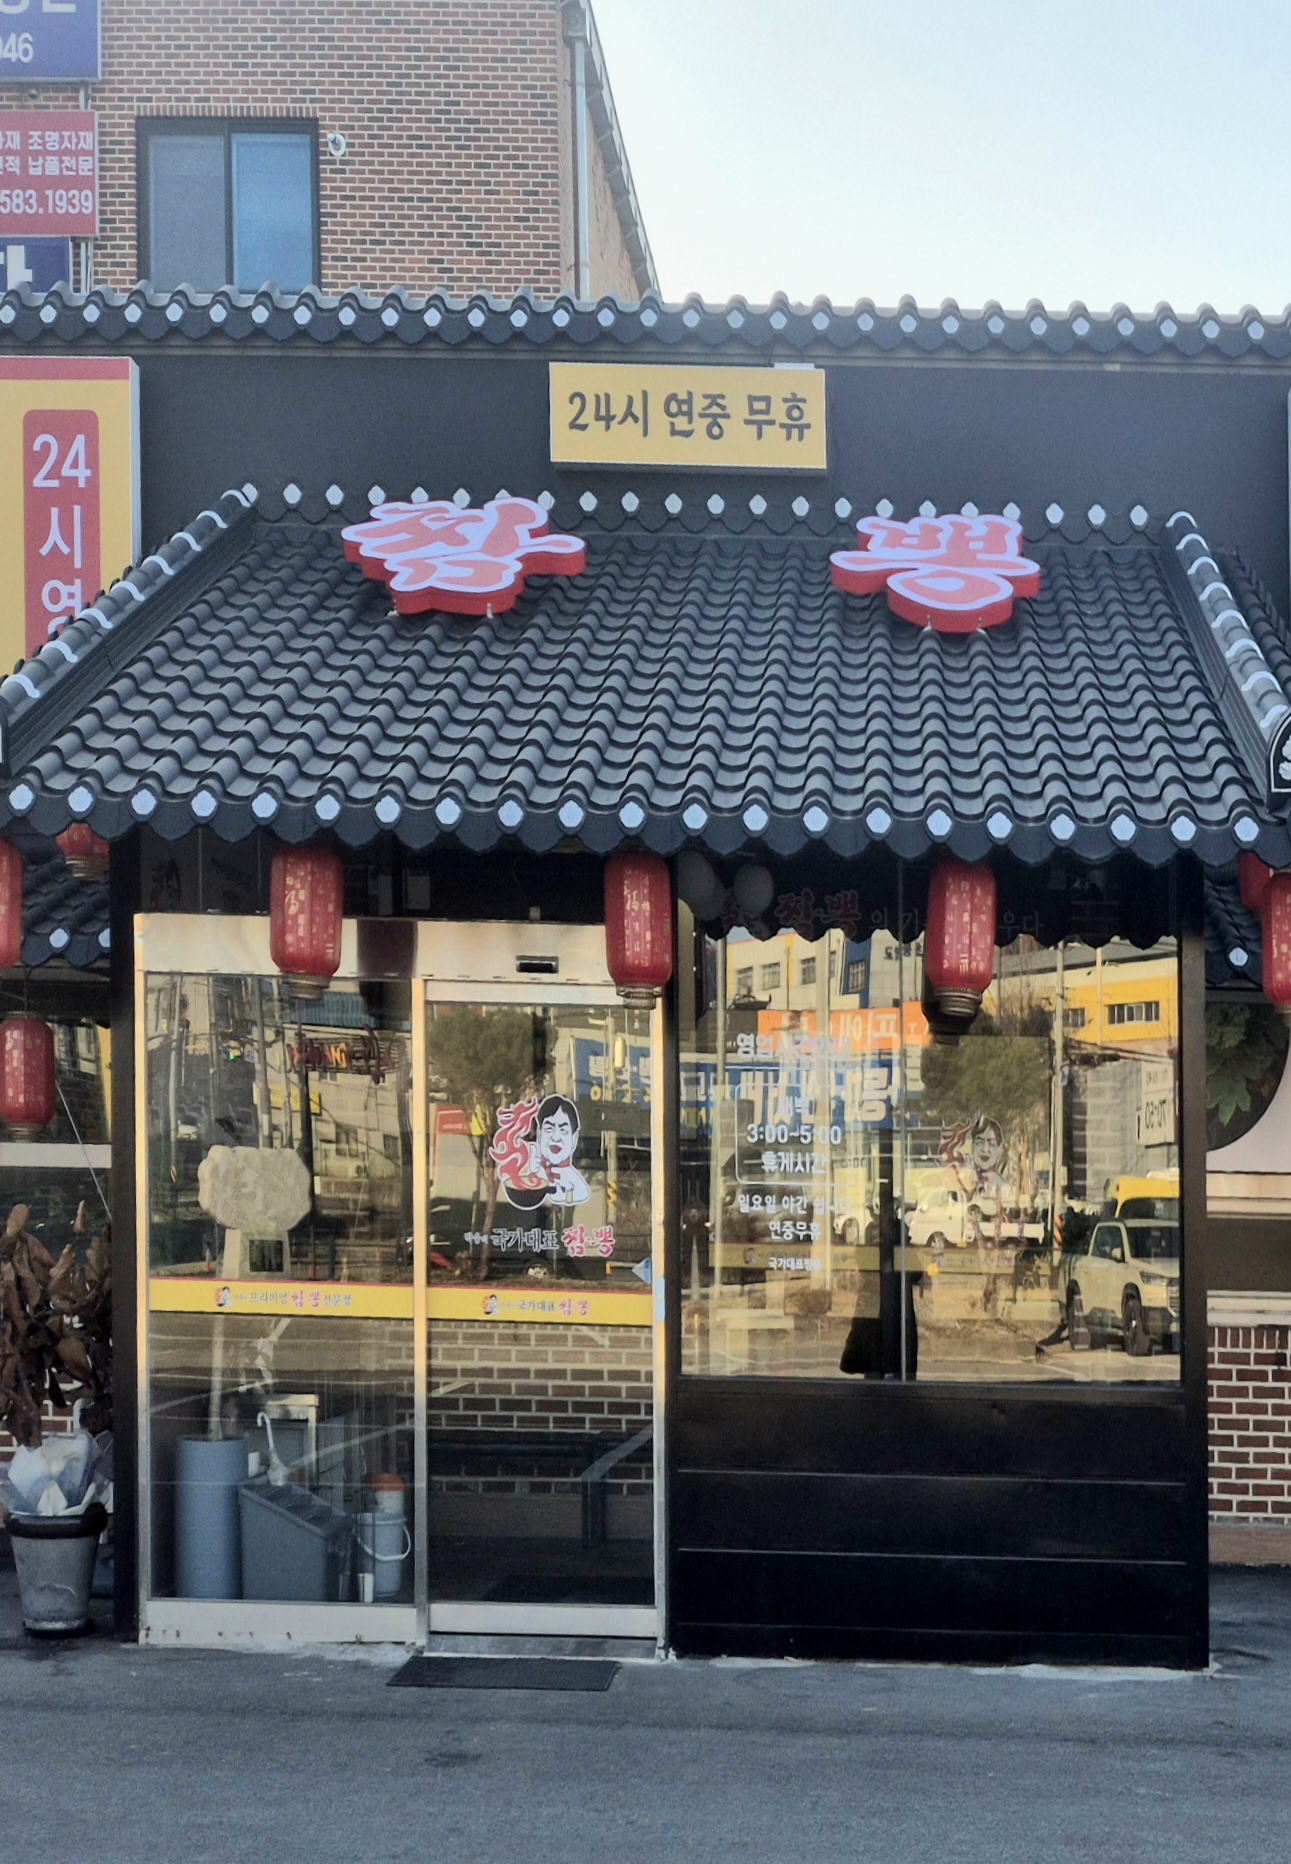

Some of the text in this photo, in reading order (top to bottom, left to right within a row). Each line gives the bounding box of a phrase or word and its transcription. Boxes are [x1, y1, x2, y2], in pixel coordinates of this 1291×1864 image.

[0, 32, 33, 63] 46
[28, 131, 93, 150] 조명자재
[28, 156, 93, 175] 납품전문
[568, 389, 812, 441] 24시 연중 무휴
[746, 1123, 842, 1145] 3:00~5:00
[761, 1150, 828, 1174] 휴게시간
[738, 1193, 776, 1213] 일요일
[782, 1195, 808, 1214] 야간
[490, 1227, 559, 1254] 국가대표
[561, 1223, 616, 1258] 짬뽕
[768, 1221, 821, 1241] 연중무휴
